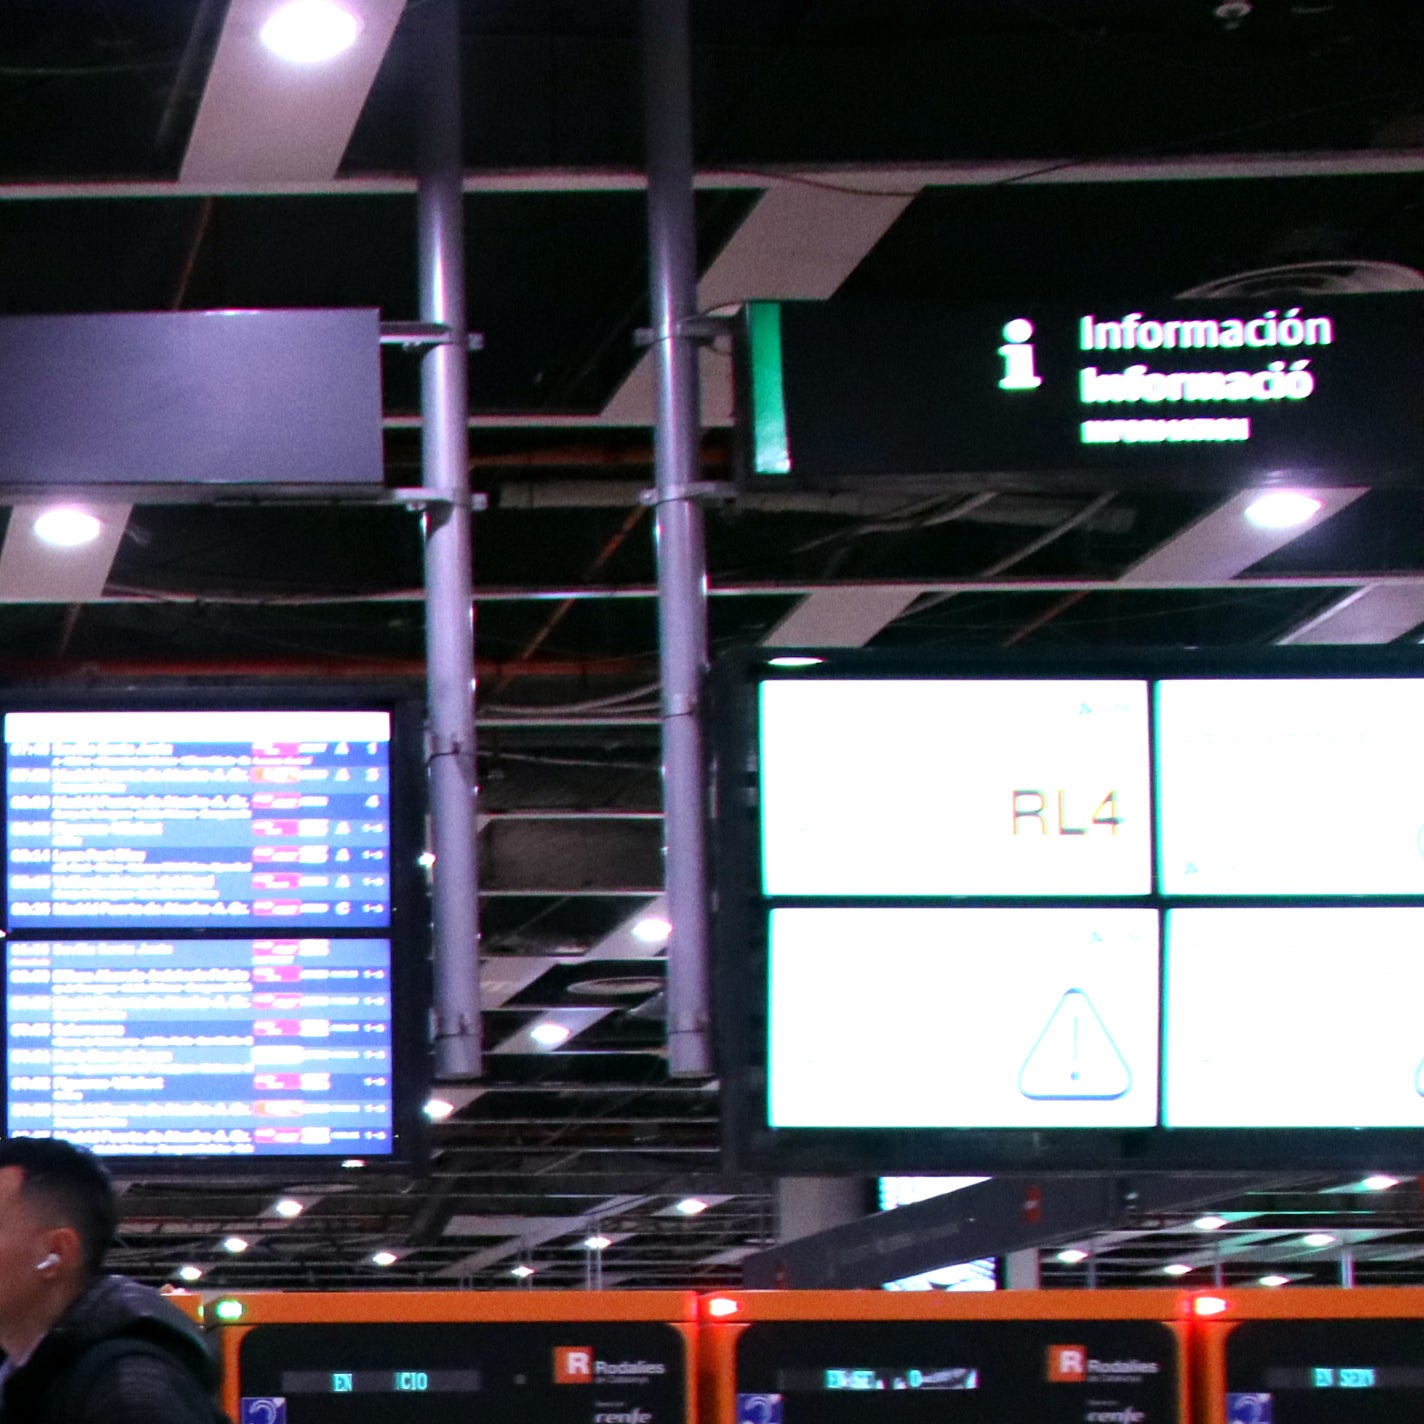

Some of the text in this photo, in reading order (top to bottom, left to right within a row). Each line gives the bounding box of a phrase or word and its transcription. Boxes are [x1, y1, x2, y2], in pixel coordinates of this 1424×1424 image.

[1081, 307, 1332, 350] Información
[1080, 359, 1315, 403] Informació
[1010, 789, 1126, 836] RL4
